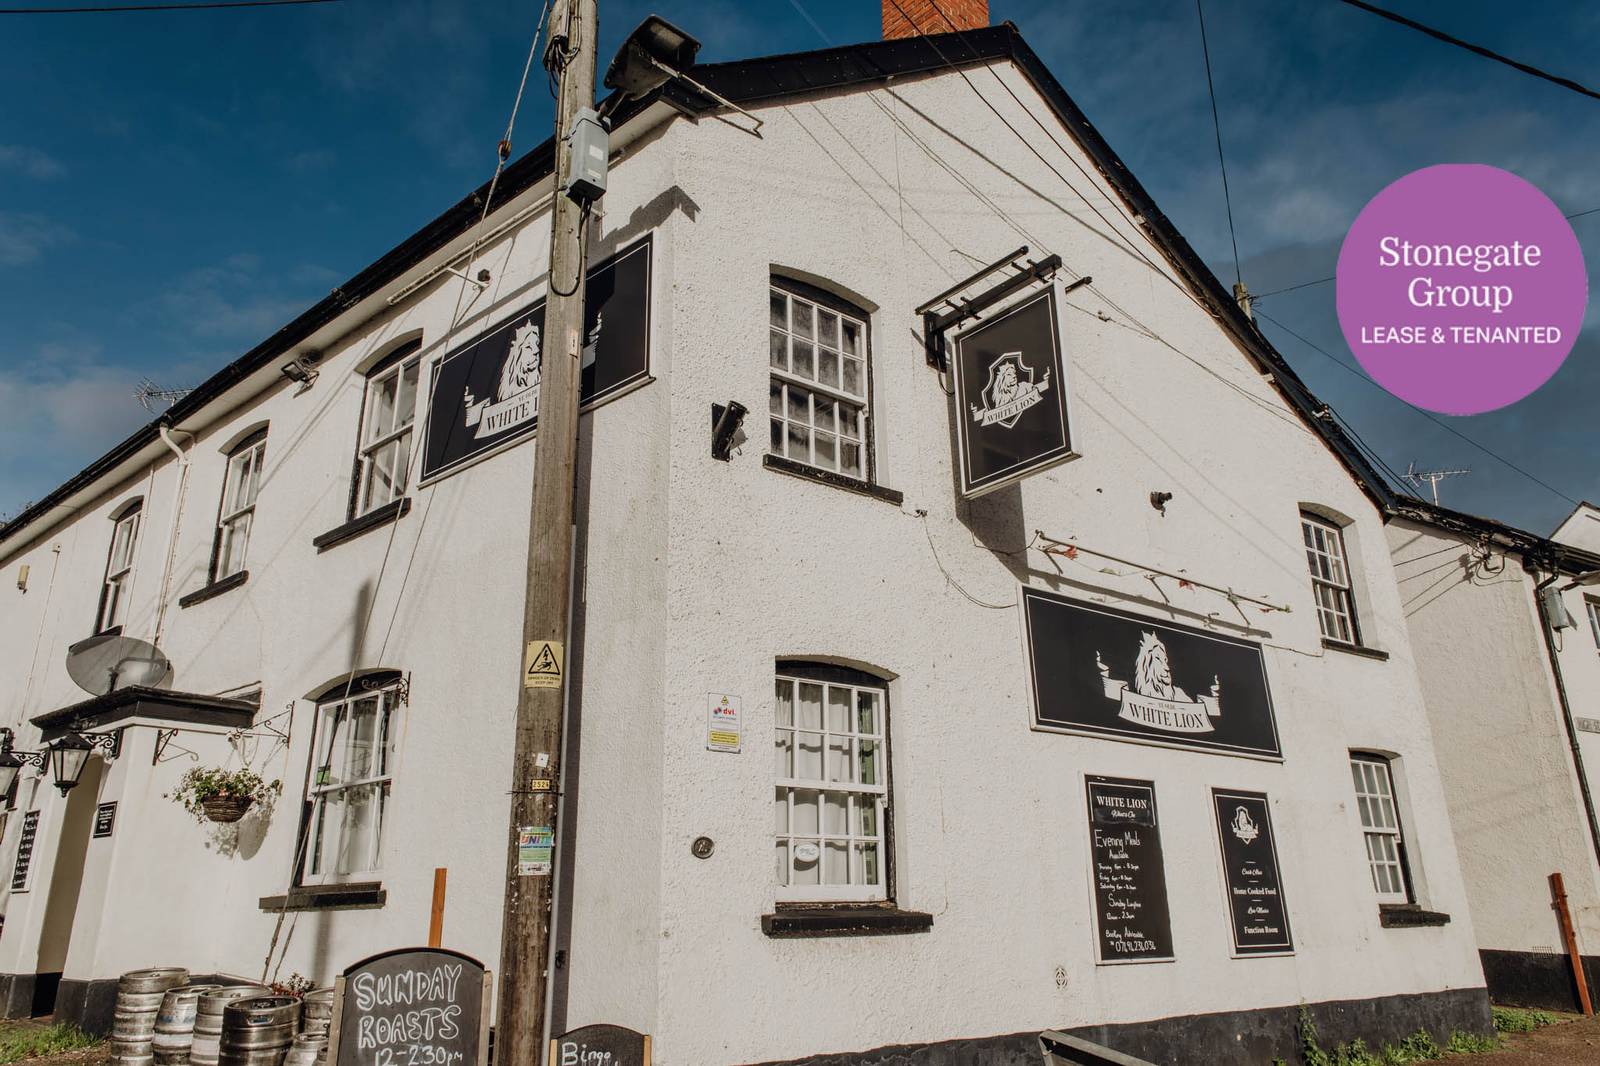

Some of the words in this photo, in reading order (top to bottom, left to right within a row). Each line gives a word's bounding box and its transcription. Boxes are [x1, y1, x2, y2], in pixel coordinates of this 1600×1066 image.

[486, 402, 530, 431] WHITE
[987, 406, 1014, 422] WHITE
[1015, 395, 1037, 413] LION
[1129, 702, 1172, 727] WHITE
[1173, 712, 1204, 729] LION
[1096, 795, 1125, 808] WHITE
[1126, 798, 1147, 809] LION
[1094, 829, 1124, 852] Evening
[1108, 893, 1126, 910] Sunday
[1247, 887, 1265, 895] Cooked
[1265, 887, 1277, 895] Food
[1244, 926, 1265, 934] Function
[1265, 926, 1279, 934] Room
[353, 964, 463, 1011] SUNDAY
[358, 1005, 463, 1049] ROASTS
[561, 1042, 612, 1066] Bingo
